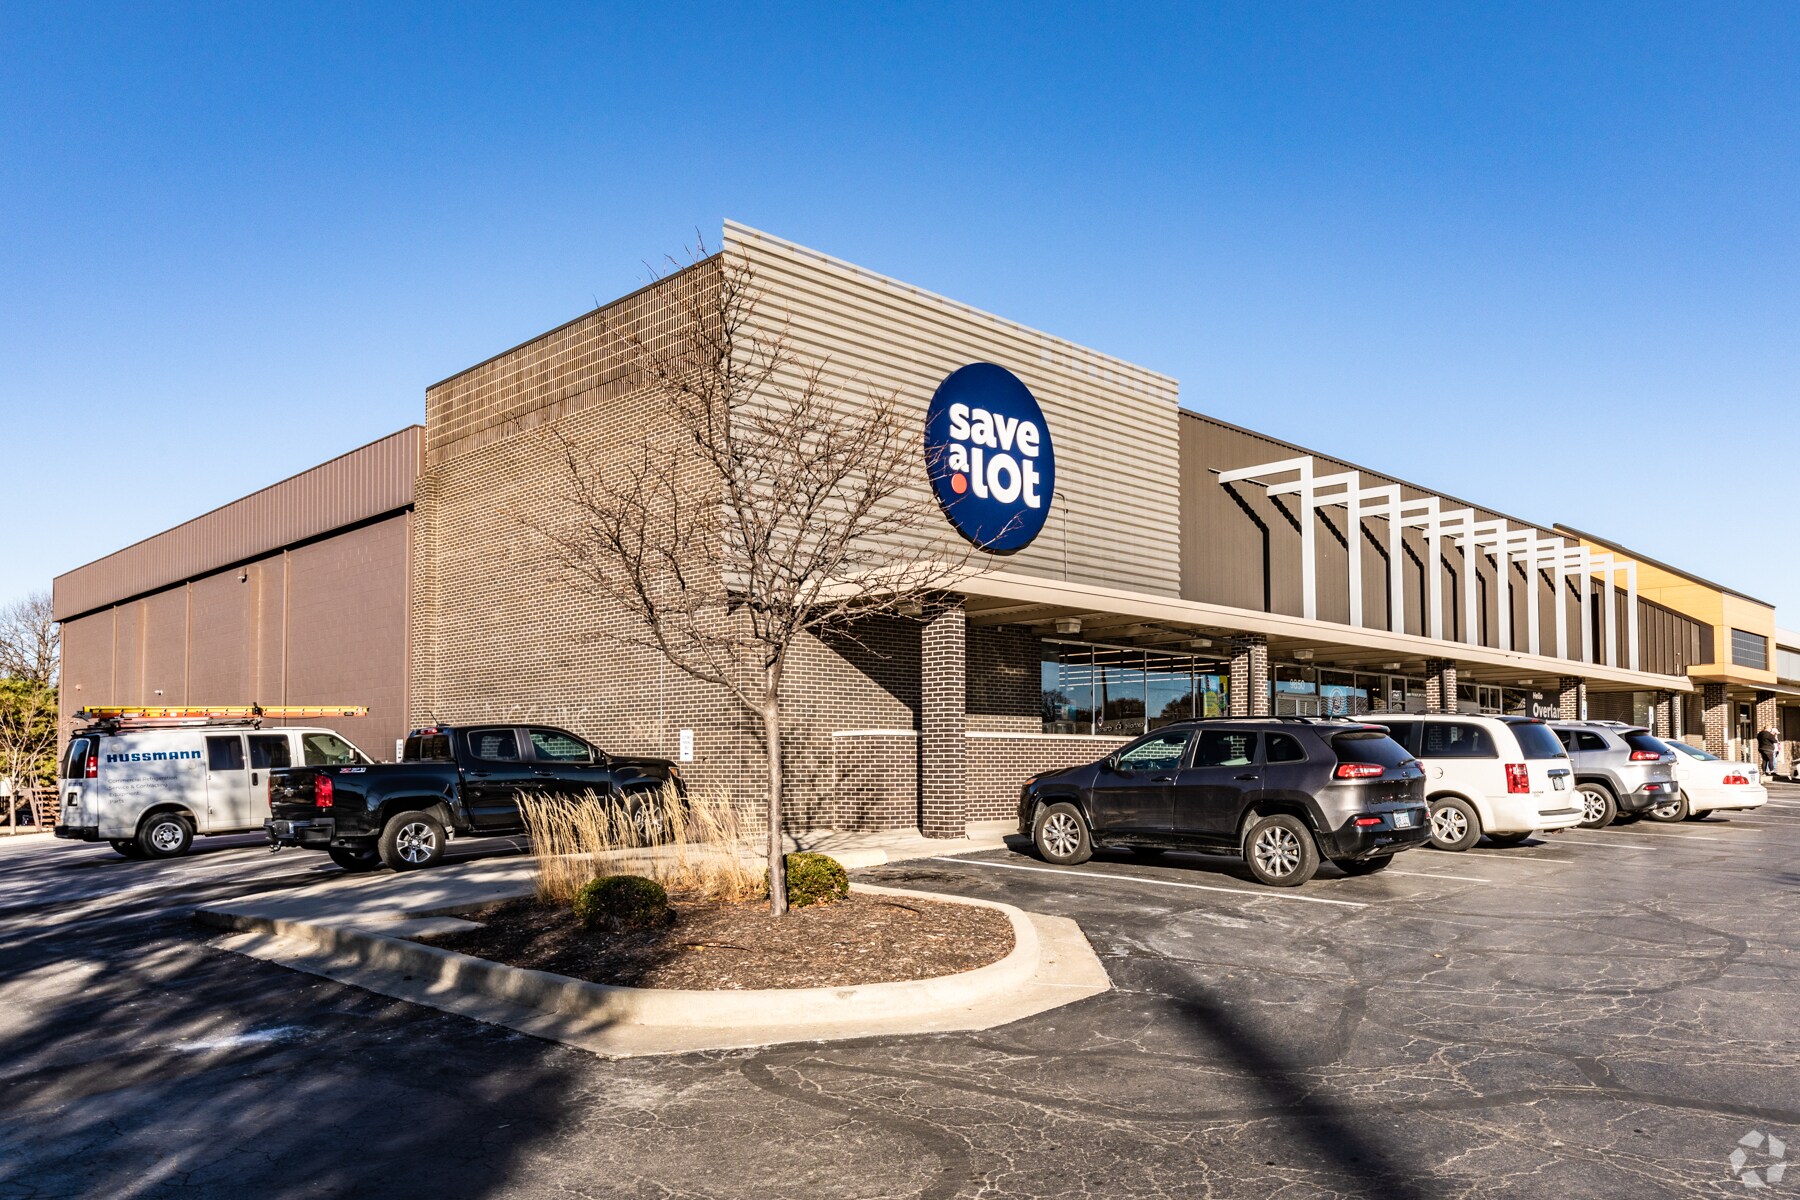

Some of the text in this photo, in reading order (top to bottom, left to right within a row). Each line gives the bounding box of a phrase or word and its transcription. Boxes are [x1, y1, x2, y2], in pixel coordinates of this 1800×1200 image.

[949, 403, 1040, 457] save
[949, 443, 969, 473] a
[1289, 678, 1306, 690] 9850
[1532, 691, 1543, 700] Hello
[106, 751, 201, 763] HUSSMANN
